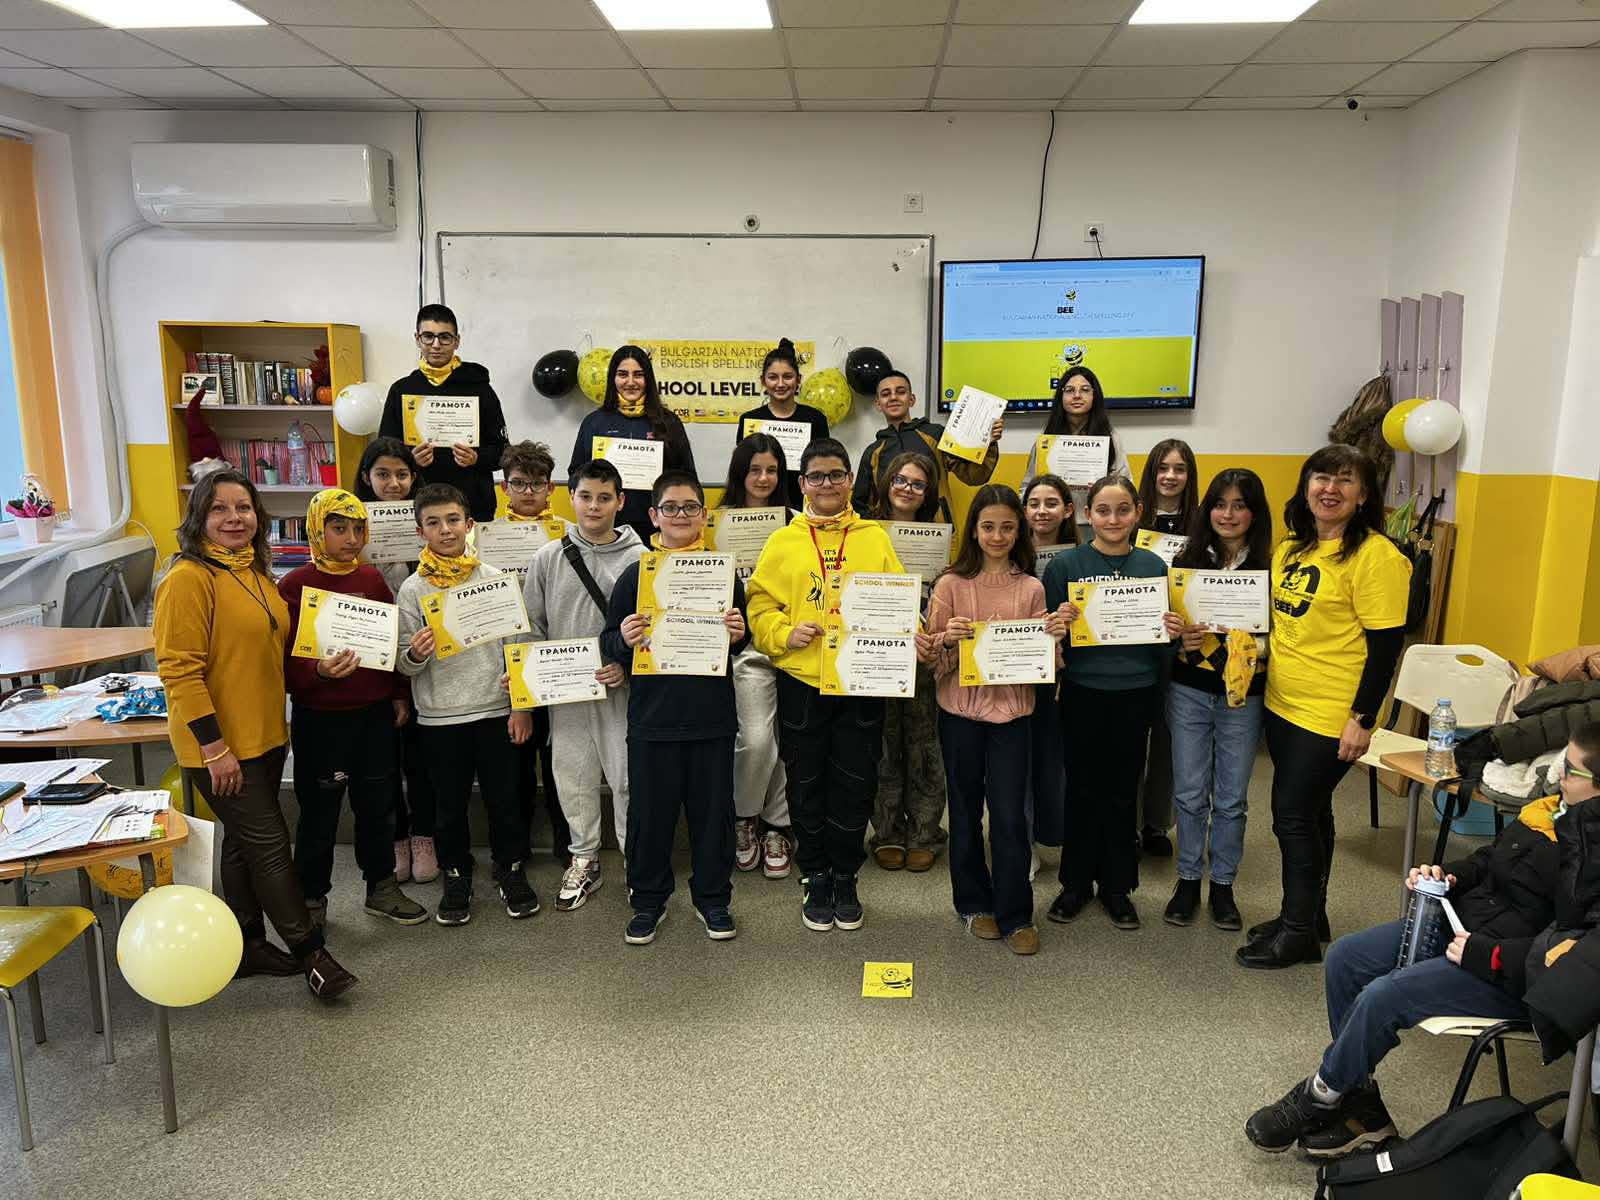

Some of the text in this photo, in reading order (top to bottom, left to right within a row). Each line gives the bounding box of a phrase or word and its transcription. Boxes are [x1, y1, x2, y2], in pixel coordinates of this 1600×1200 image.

[1057, 306, 1074, 314] BEE
[660, 346, 769, 358] BULGARIAN NATIO
[661, 358, 709, 368] ENGLISH
[657, 381, 707, 396] HOOL
[711, 381, 760, 396] LEVEL
[618, 444, 656, 452] ГРАМОТА
[373, 508, 416, 516] ГРАМОТ
[732, 514, 776, 522] ГРАМОТА
[1203, 577, 1257, 586] ГРАМОТА
[457, 581, 508, 600] ГРАМОТА
[1105, 586, 1157, 596] ГРАМОТА
[338, 602, 388, 618] ГРАМОТА
[995, 626, 1044, 634] ГРАМОТА
[857, 639, 906, 648] ГРАМОТА
[540, 646, 588, 656] ГРАМОТА
